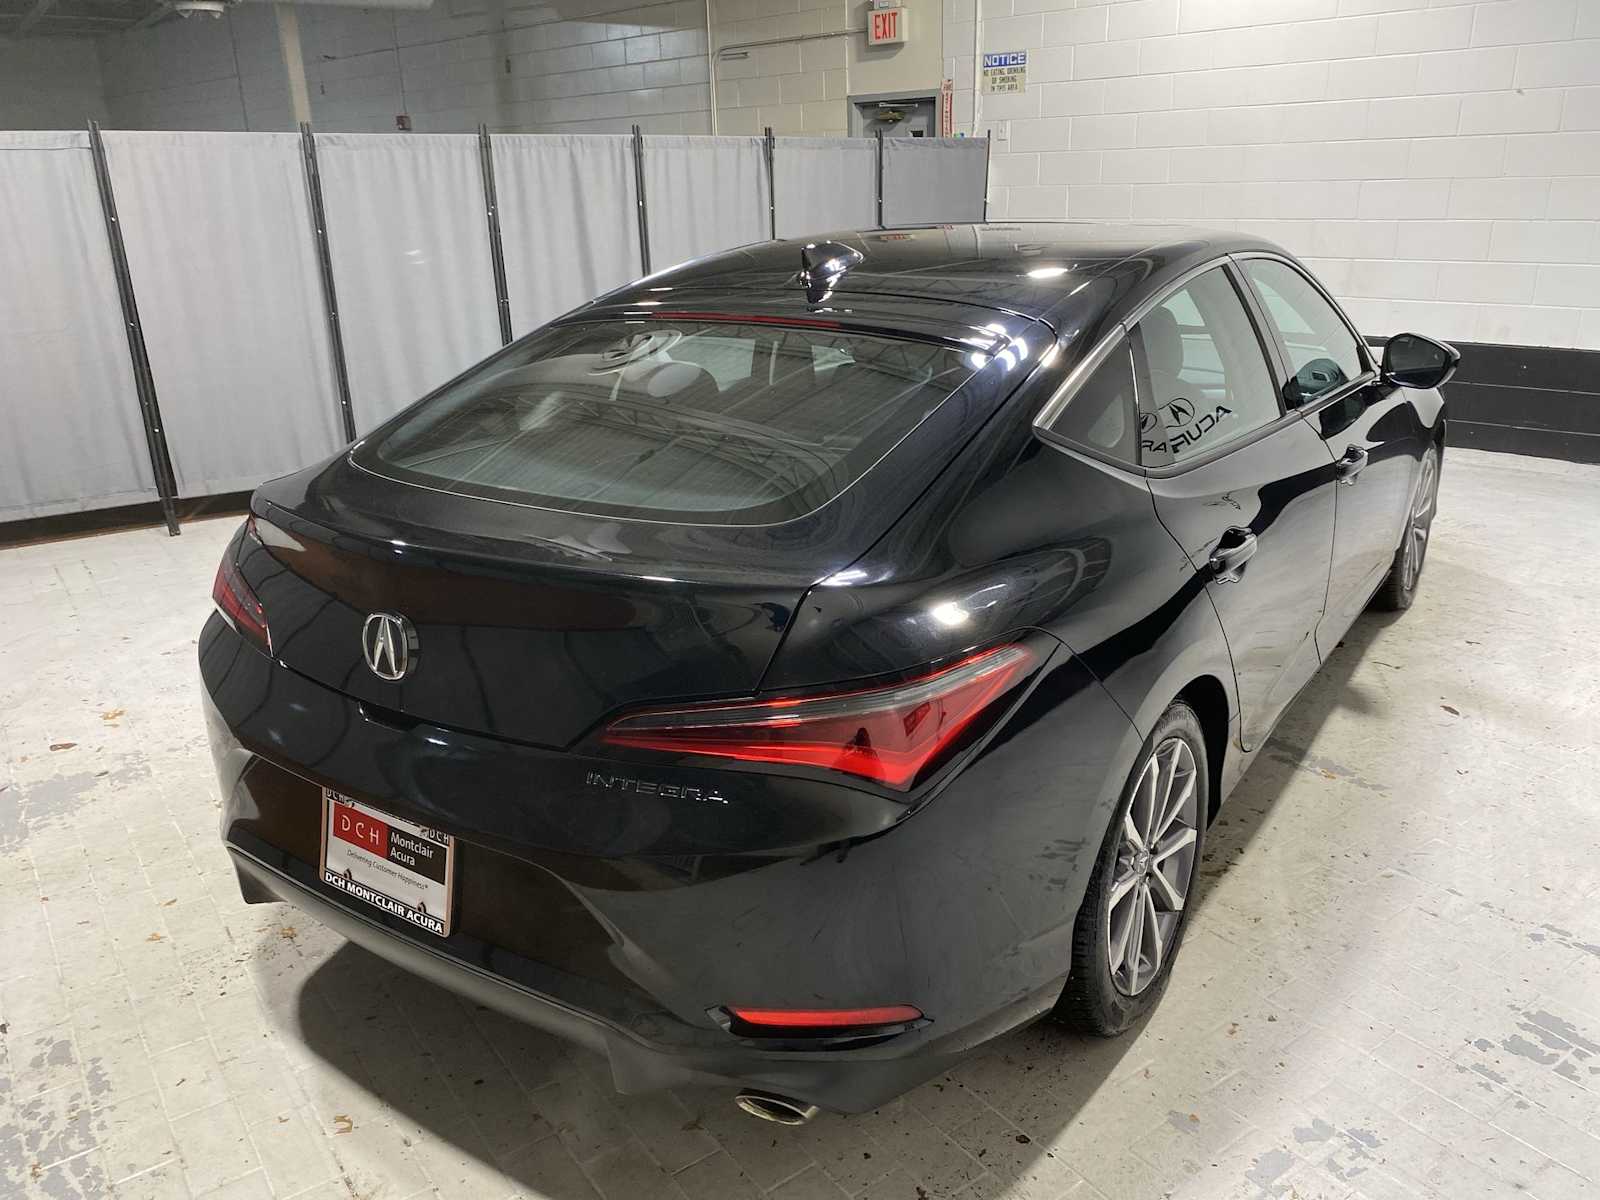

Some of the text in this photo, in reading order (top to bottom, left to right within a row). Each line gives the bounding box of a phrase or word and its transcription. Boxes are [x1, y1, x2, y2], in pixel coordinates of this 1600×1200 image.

[874, 12, 898, 40] EXIT
[983, 53, 1025, 66] NOTICE
[586, 769, 729, 805] INTEGRA
[341, 814, 379, 845] DCH
[428, 828, 449, 844] DCH
[390, 831, 433, 859] Montclair
[390, 846, 416, 866] Acura
[372, 861, 398, 877] Customer
[325, 871, 443, 934] DCH MONTCLAIR ACURA
